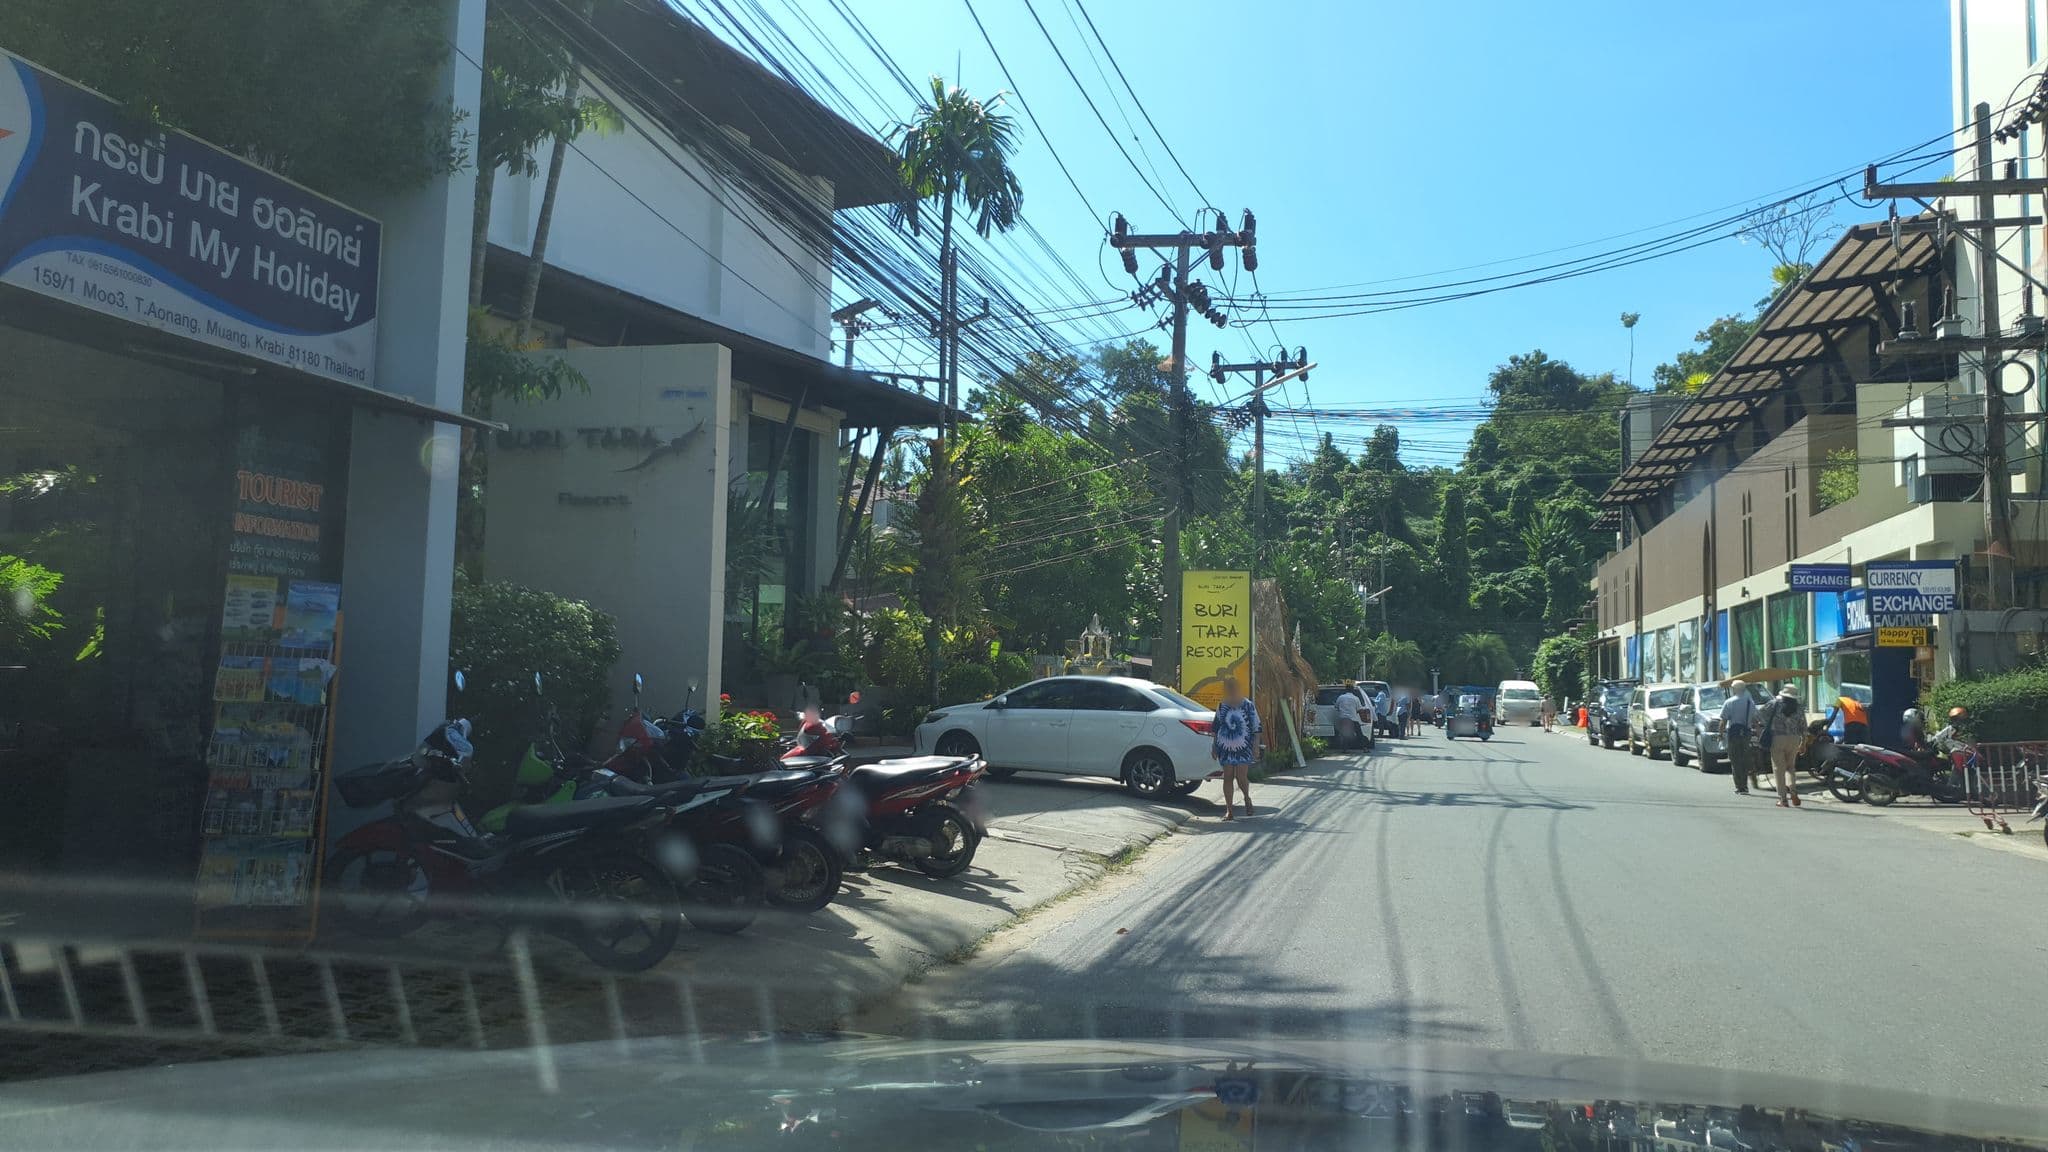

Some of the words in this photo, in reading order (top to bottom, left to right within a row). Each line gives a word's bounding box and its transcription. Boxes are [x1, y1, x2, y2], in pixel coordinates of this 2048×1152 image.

[74, 121, 167, 185] กระบี่
[179, 163, 240, 217] มาย
[252, 197, 364, 267] ฮอลิเดย์
[71, 174, 174, 249] Krabi
[189, 220, 240, 279] My
[253, 244, 360, 322] Holiday
[33, 265, 75, 293] 159/1
[255, 334, 285, 356] Krabi
[288, 344, 320, 368] 81180
[323, 355, 365, 382] Thailand
[237, 472, 322, 511] TOURIST
[235, 513, 320, 540] INFORMATION
[1792, 575, 1850, 586] EXCHANGE
[1869, 571, 1923, 587] CURRENCY
[1194, 603, 1237, 617] BURI
[1872, 595, 1954, 612] EXCHANGE
[1192, 625, 1239, 638] TARA
[1880, 629, 1909, 638] Happy
[1911, 628, 1924, 636] Oil
[1186, 646, 1243, 658] RESORT
